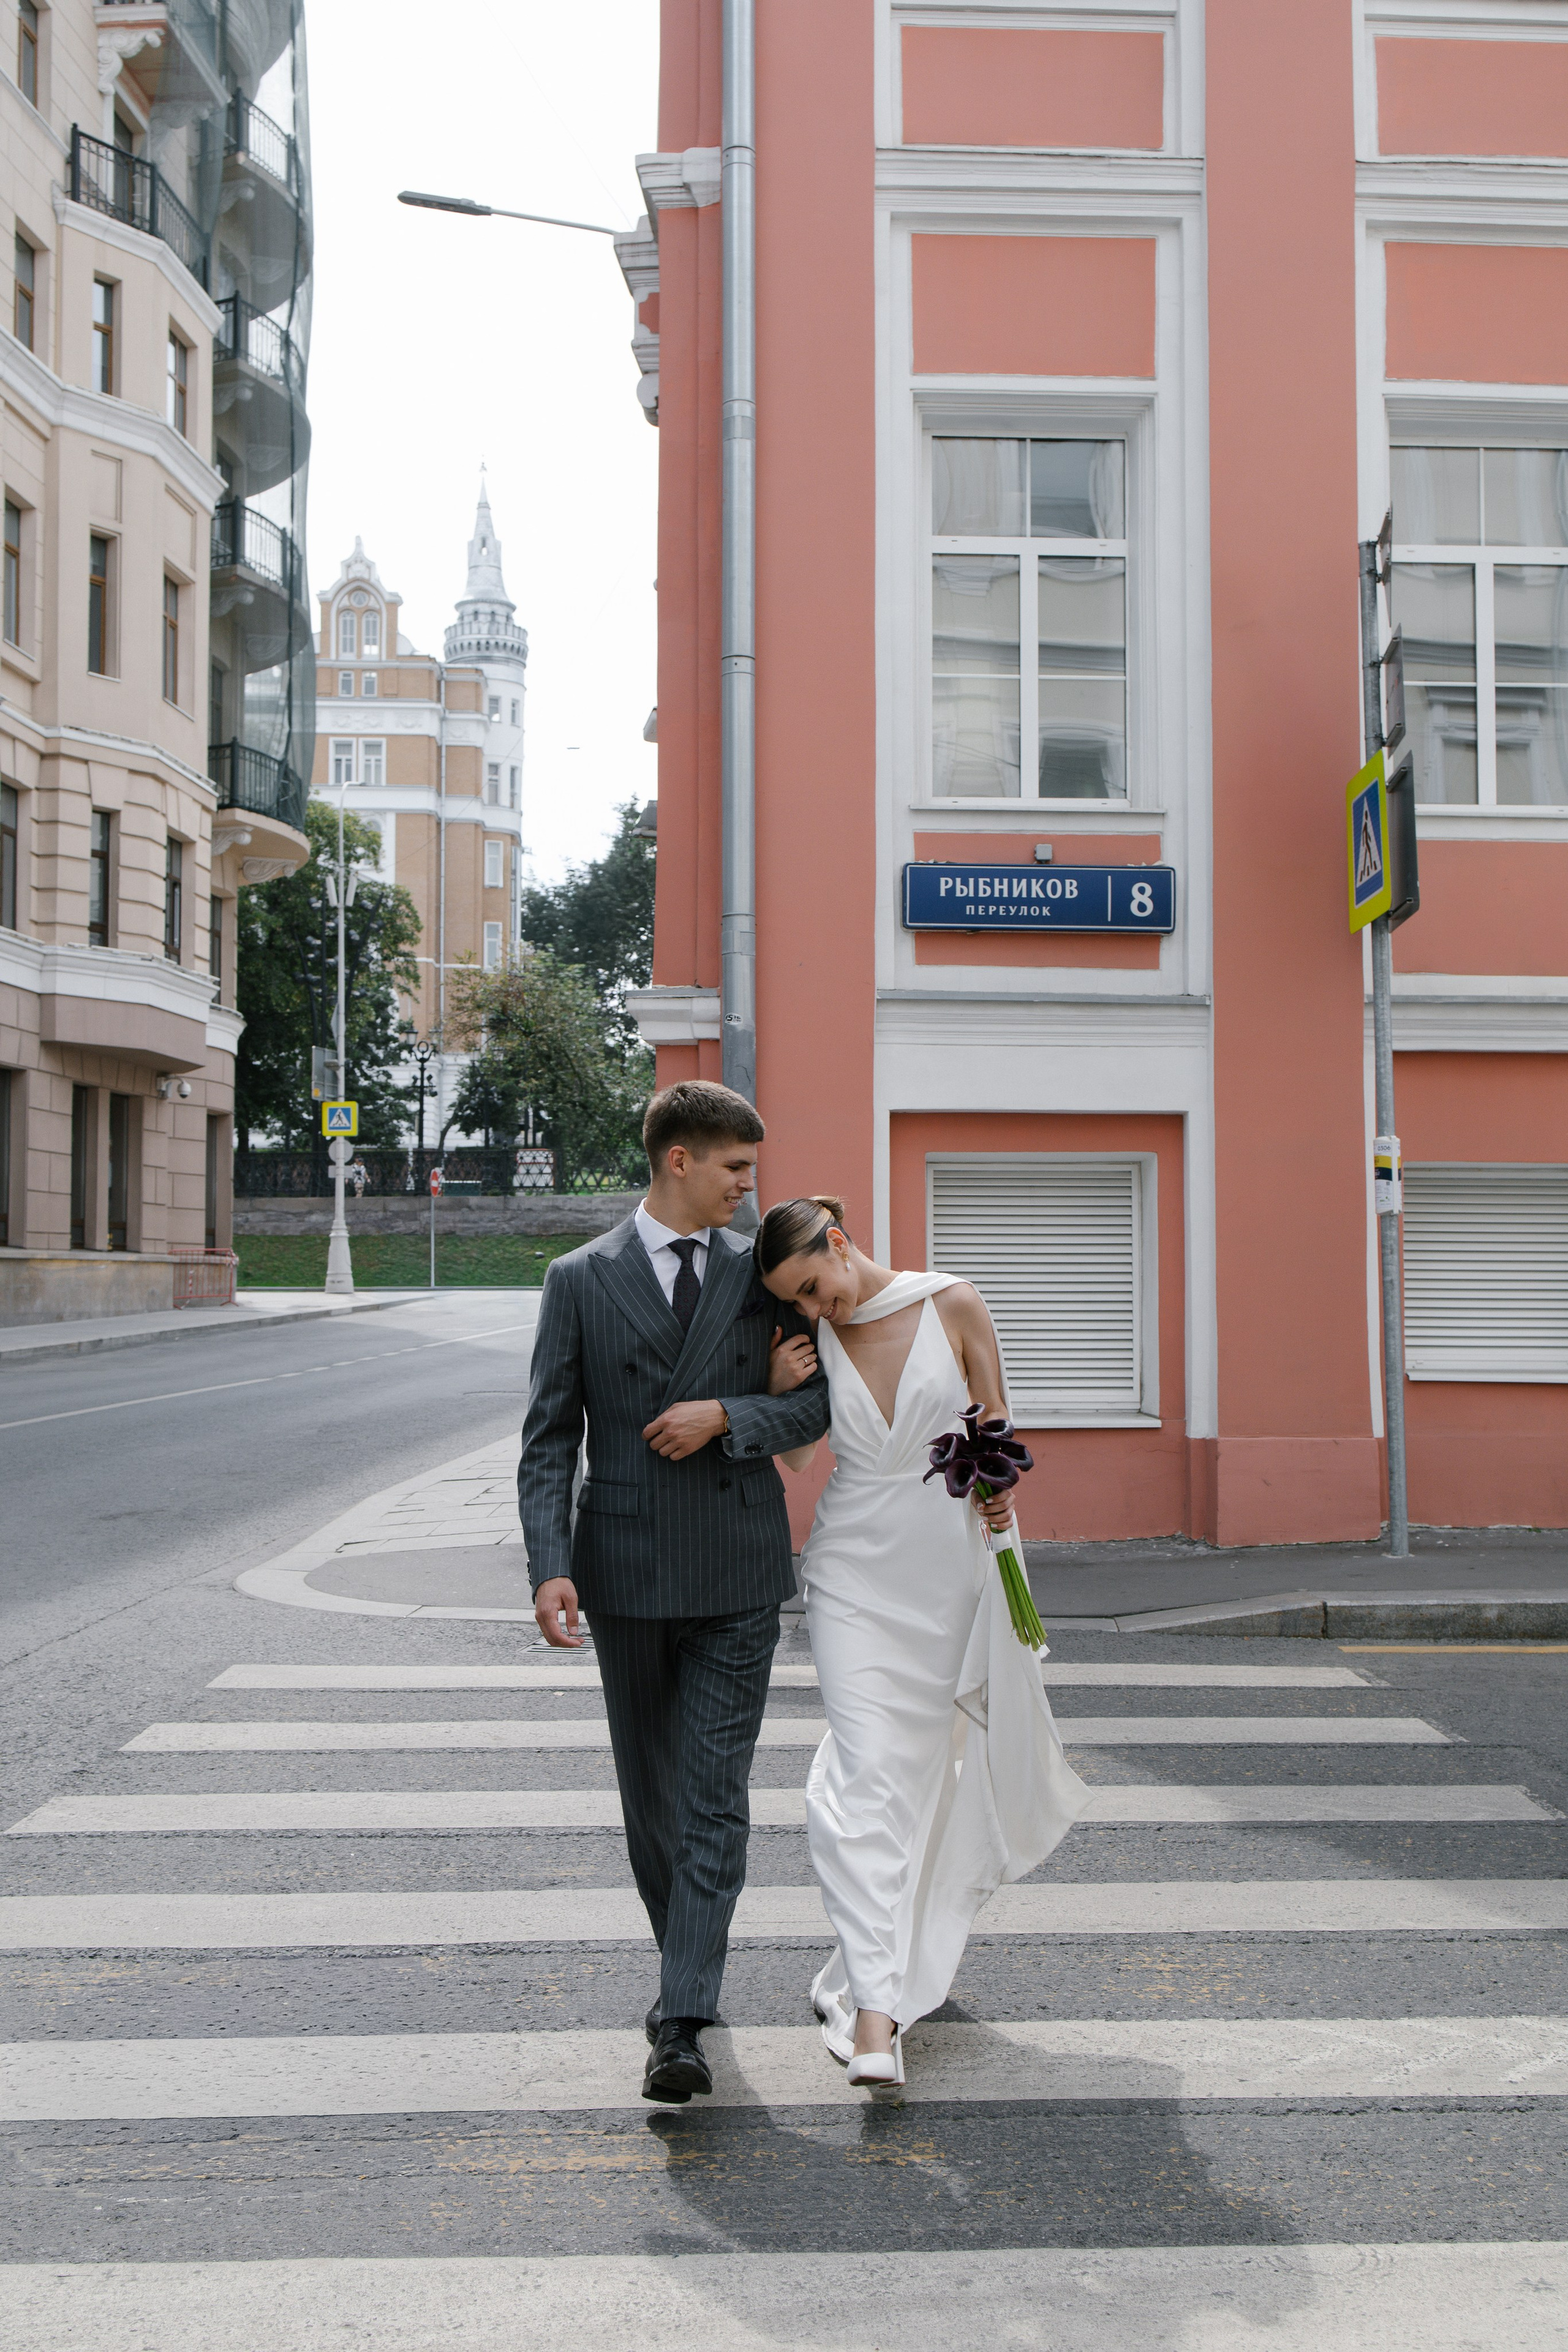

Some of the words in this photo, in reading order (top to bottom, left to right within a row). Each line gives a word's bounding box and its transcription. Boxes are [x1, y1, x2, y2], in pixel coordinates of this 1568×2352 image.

[940, 877, 1079, 899] РЫБНИКОВ
[966, 905, 1051, 916] ПЕРЕУЛОК
[1130, 882, 1154, 917] 8
